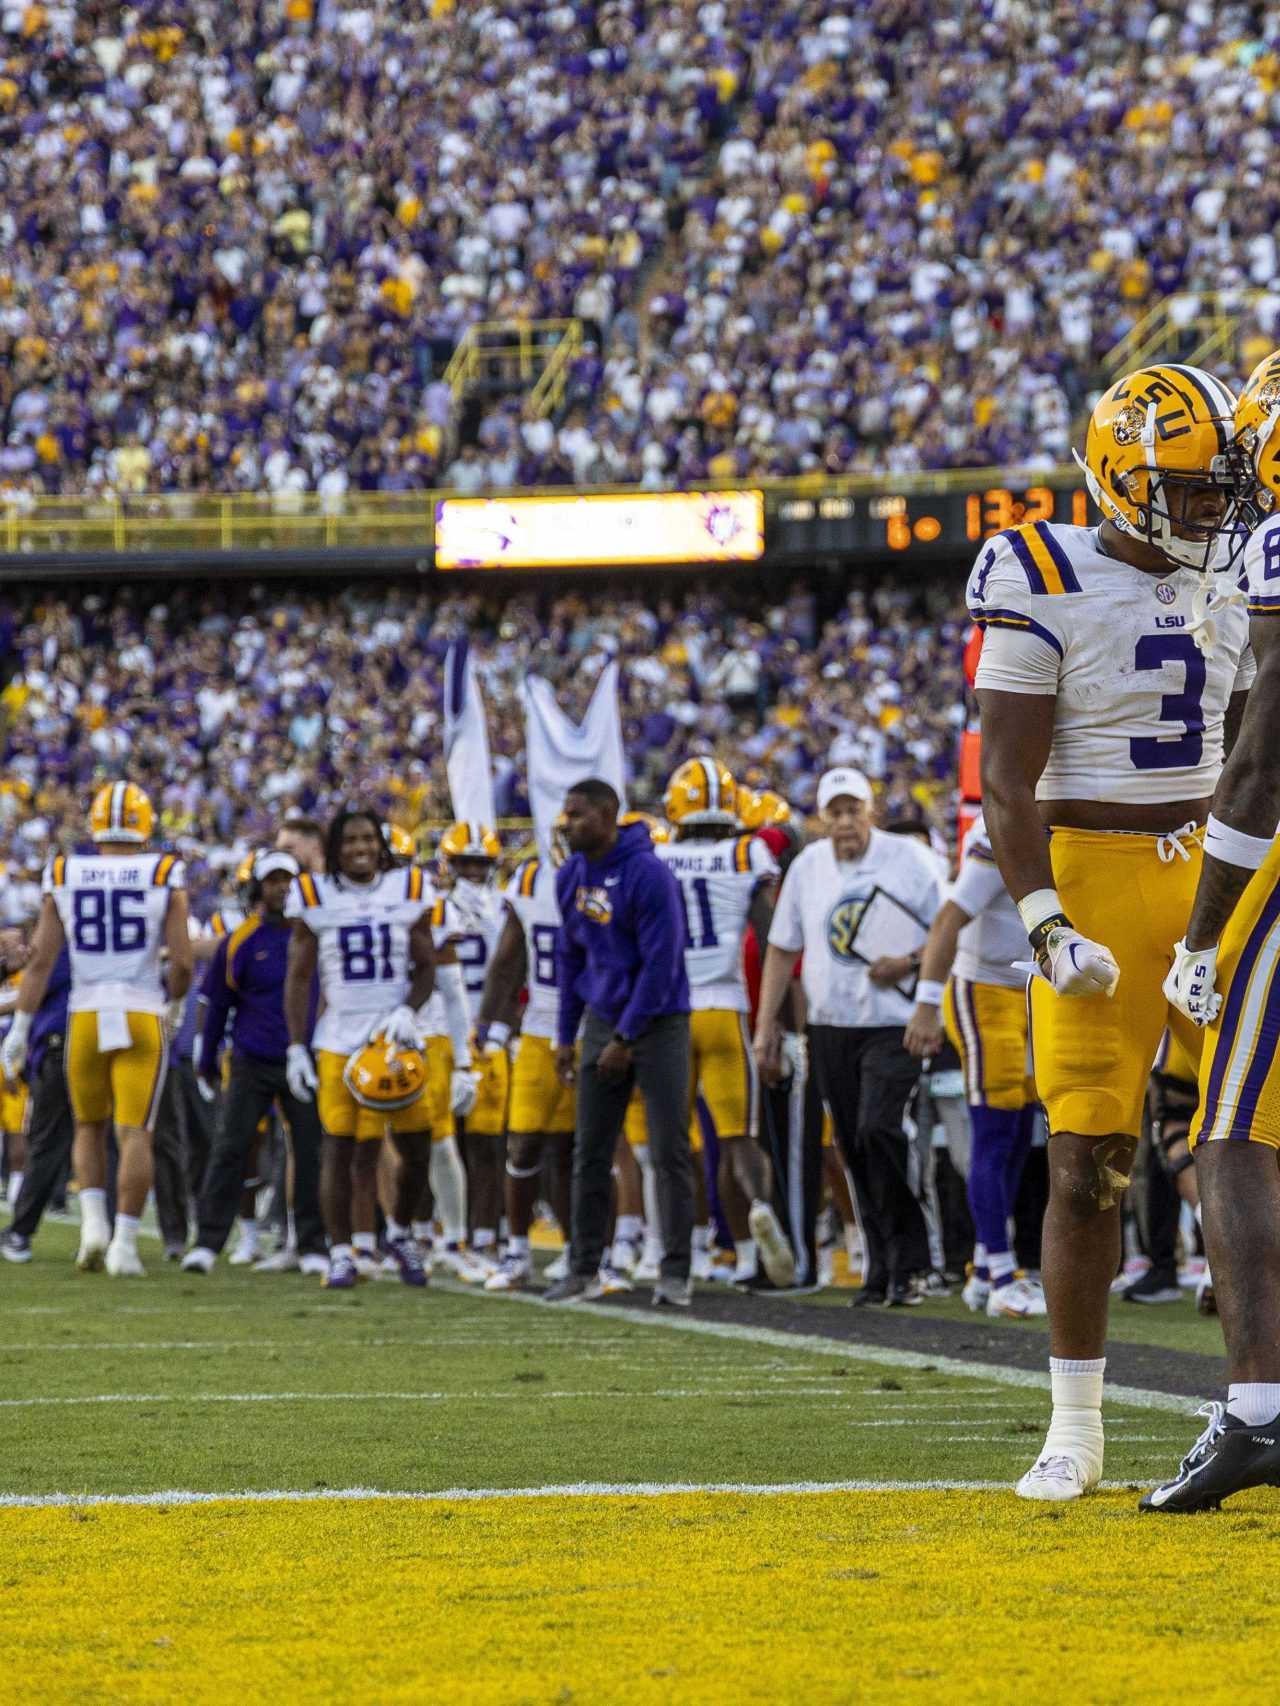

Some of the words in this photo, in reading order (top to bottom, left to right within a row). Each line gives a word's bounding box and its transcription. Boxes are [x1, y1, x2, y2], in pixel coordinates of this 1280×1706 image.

[973, 548, 996, 602] 3
[1155, 616, 1185, 628] LSU
[1130, 634, 1206, 770] 3
[75, 890, 146, 951] 86
[340, 924, 394, 980] 81
